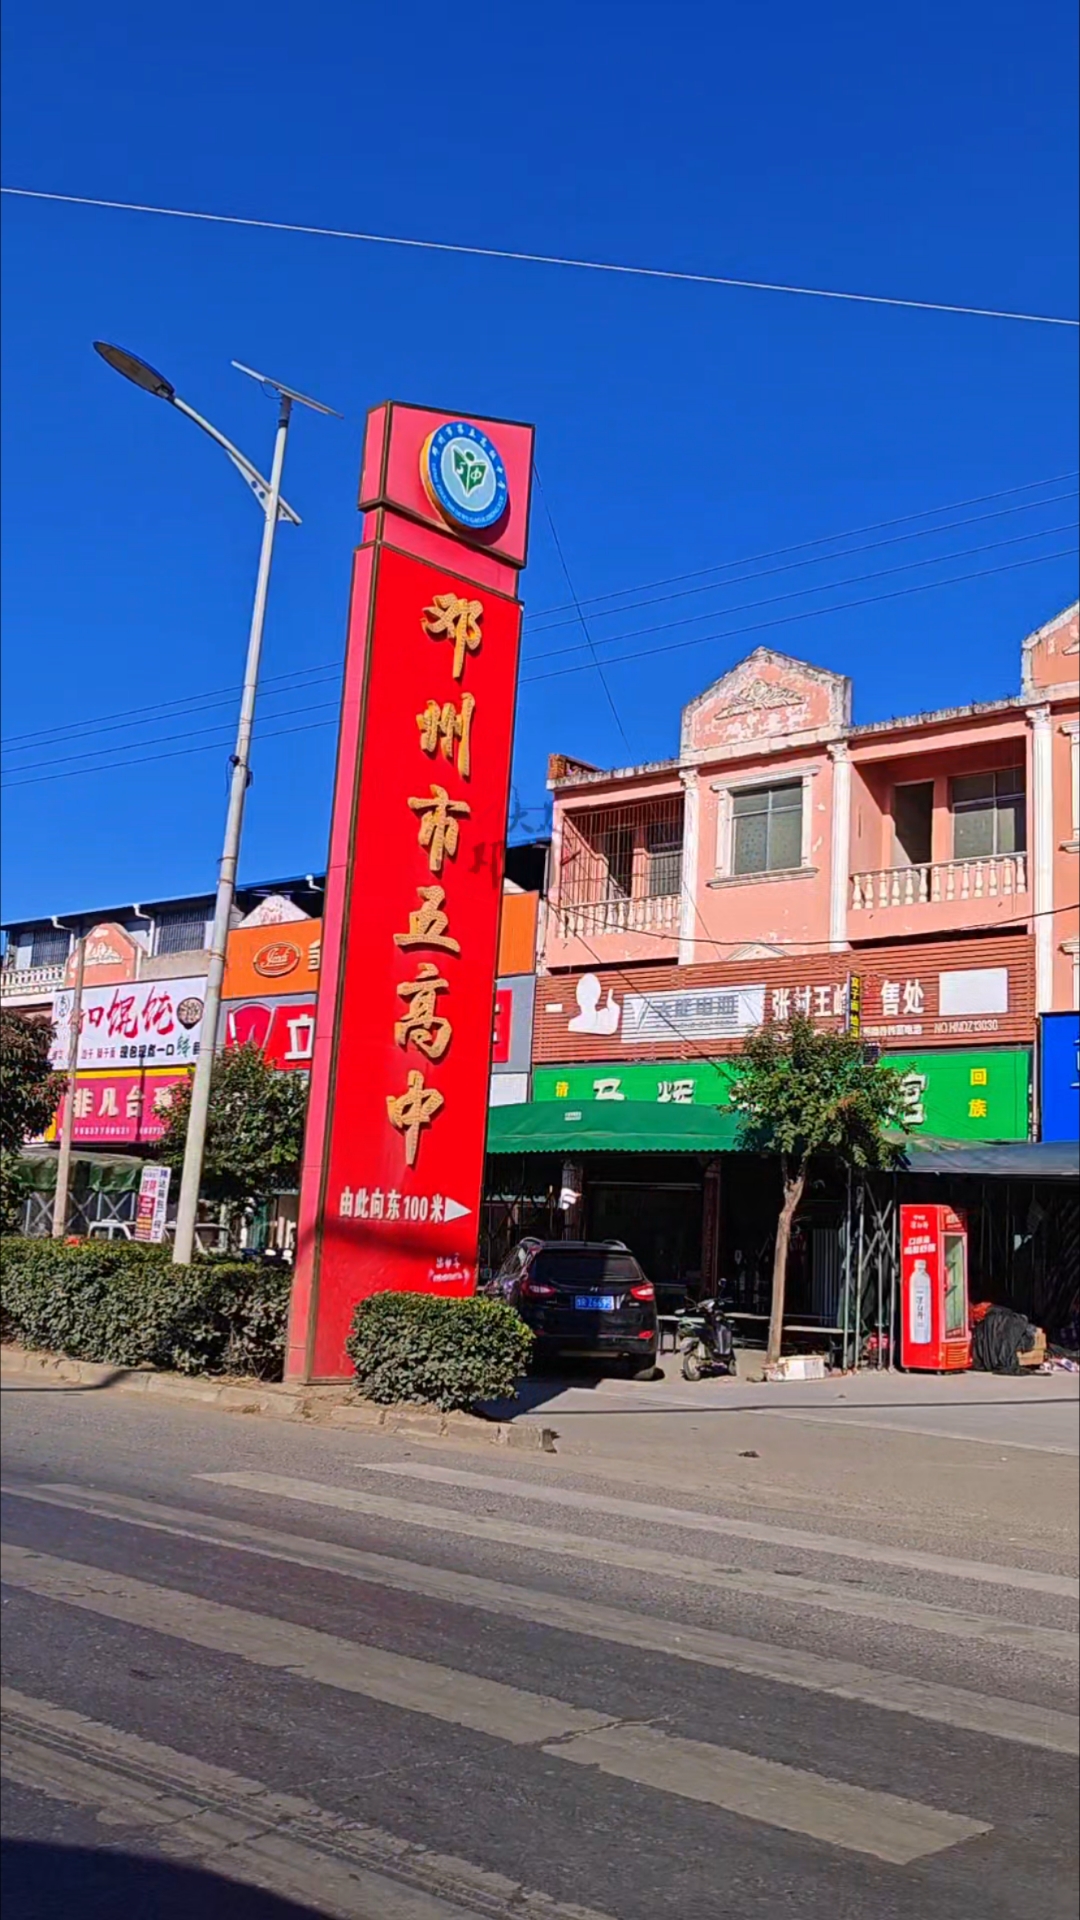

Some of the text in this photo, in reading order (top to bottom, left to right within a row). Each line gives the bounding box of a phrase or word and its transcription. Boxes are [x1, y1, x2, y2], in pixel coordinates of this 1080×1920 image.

[386, 593, 483, 1165] 邓州市五高中
[68, 985, 174, 1039] 口馄饨
[969, 1068, 987, 1118] 回族
[339, 1186, 444, 1223] 由此向东100米
